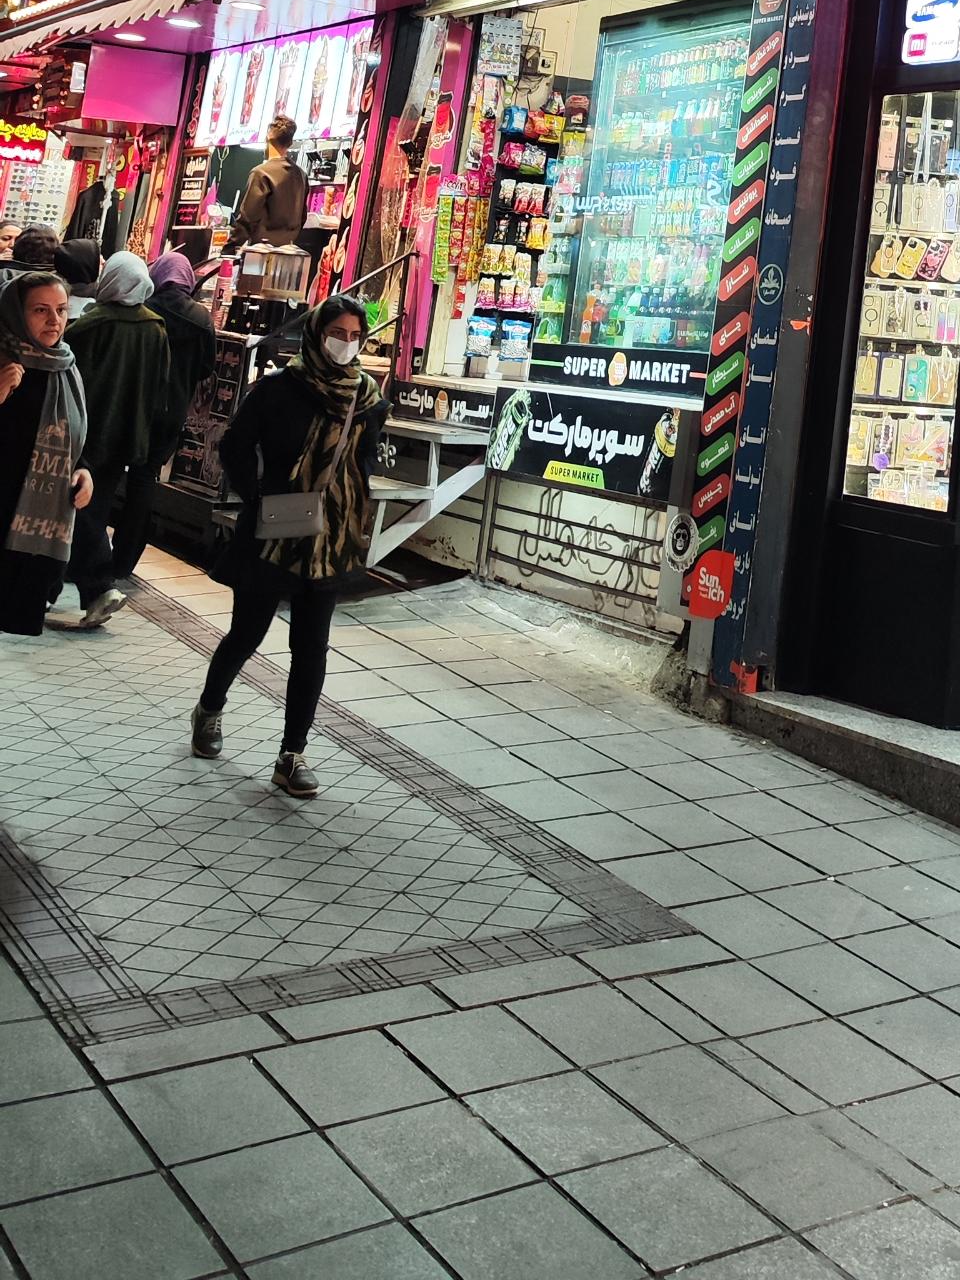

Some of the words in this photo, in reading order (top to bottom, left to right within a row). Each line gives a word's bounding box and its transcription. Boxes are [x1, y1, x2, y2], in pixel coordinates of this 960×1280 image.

[779, 84, 807, 107] گرم
[770, 162, 797, 186] فود
[764, 208, 792, 230] صبحانه
[728, 224, 755, 255] تنقلات
[719, 321, 742, 347] چای
[750, 326, 778, 350] فضای
[563, 356, 606, 379] SUPER
[628, 361, 691, 384] MARKET
[399, 388, 434, 413] مارکت
[451, 401, 490, 421] سوپر
[527, 412, 645, 465] سوپرمارکت
[700, 439, 730, 468] قهوه
[549, 465, 571, 479] SUPER
[571, 468, 600, 484] MARKET
[698, 566, 720, 588] Sun
